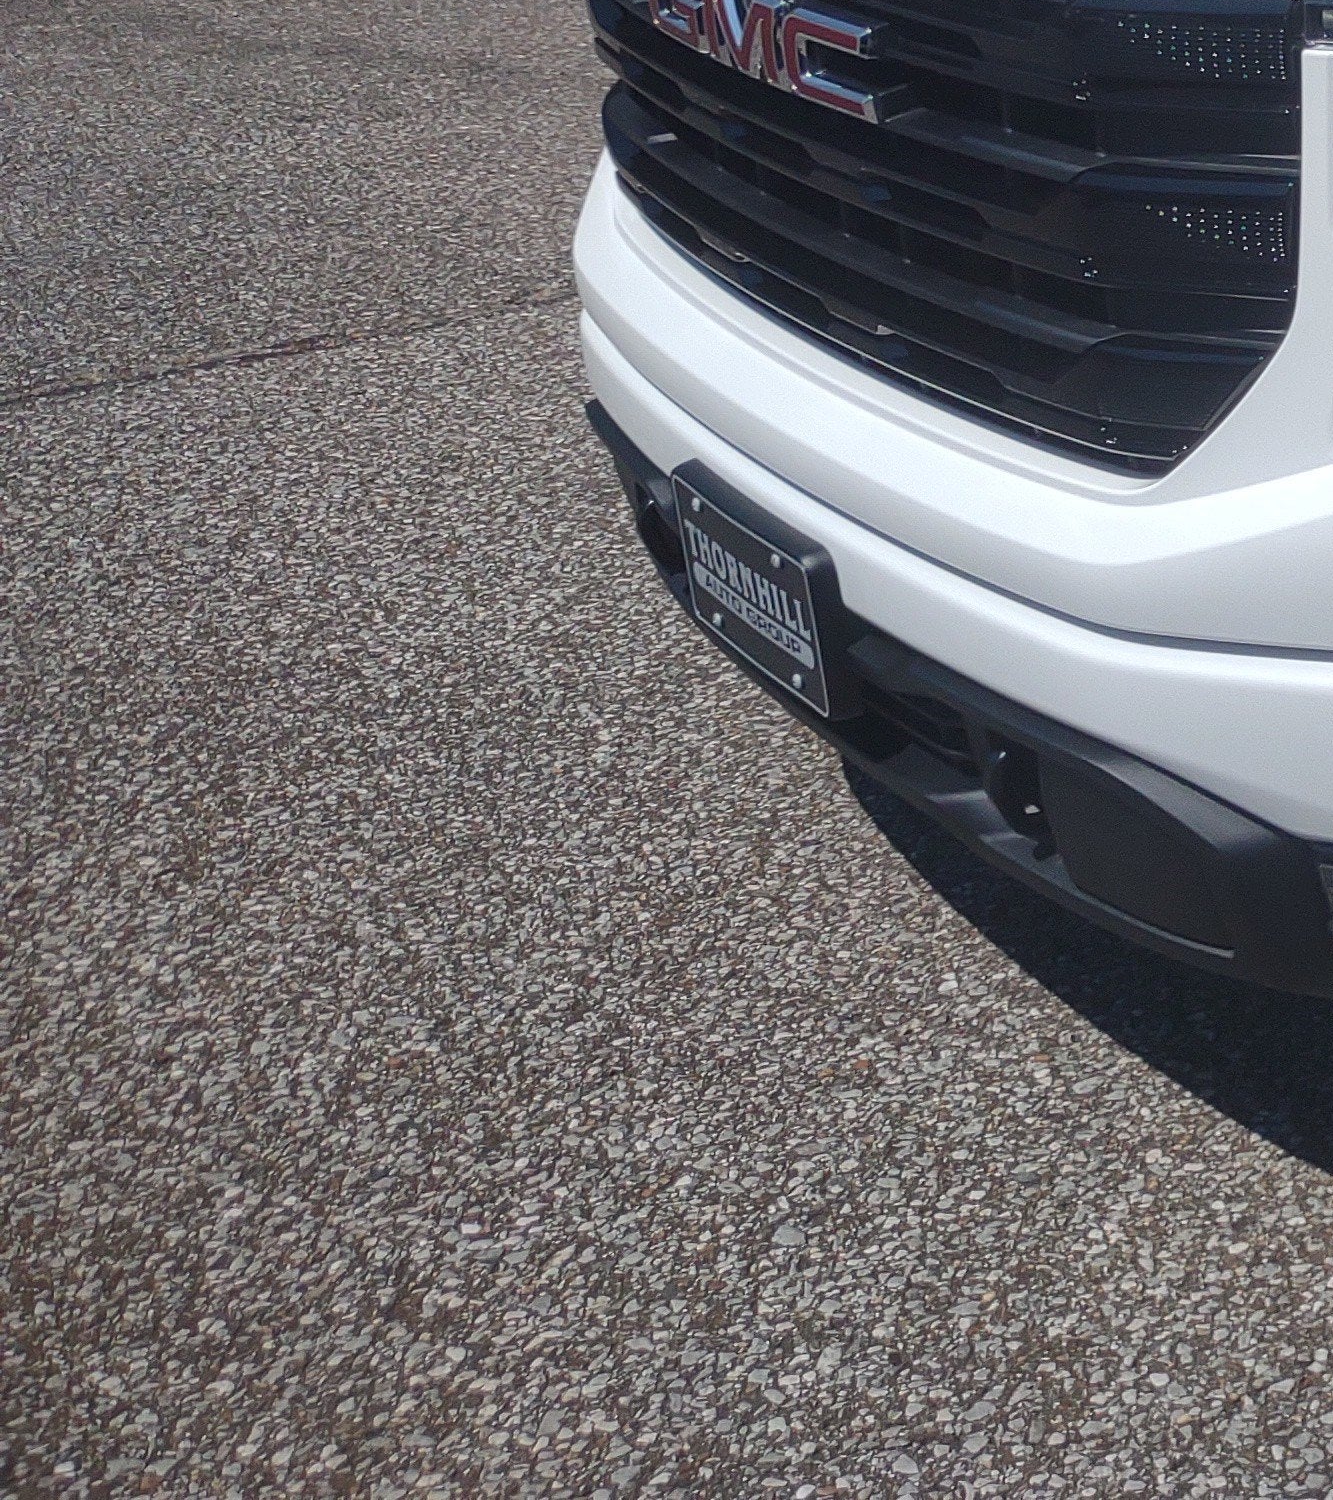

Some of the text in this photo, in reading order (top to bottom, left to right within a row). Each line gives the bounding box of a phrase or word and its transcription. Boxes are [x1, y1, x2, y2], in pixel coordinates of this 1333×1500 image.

[684, 519, 812, 642] THORNHILL
[705, 573, 802, 653] AUTO GROUP
